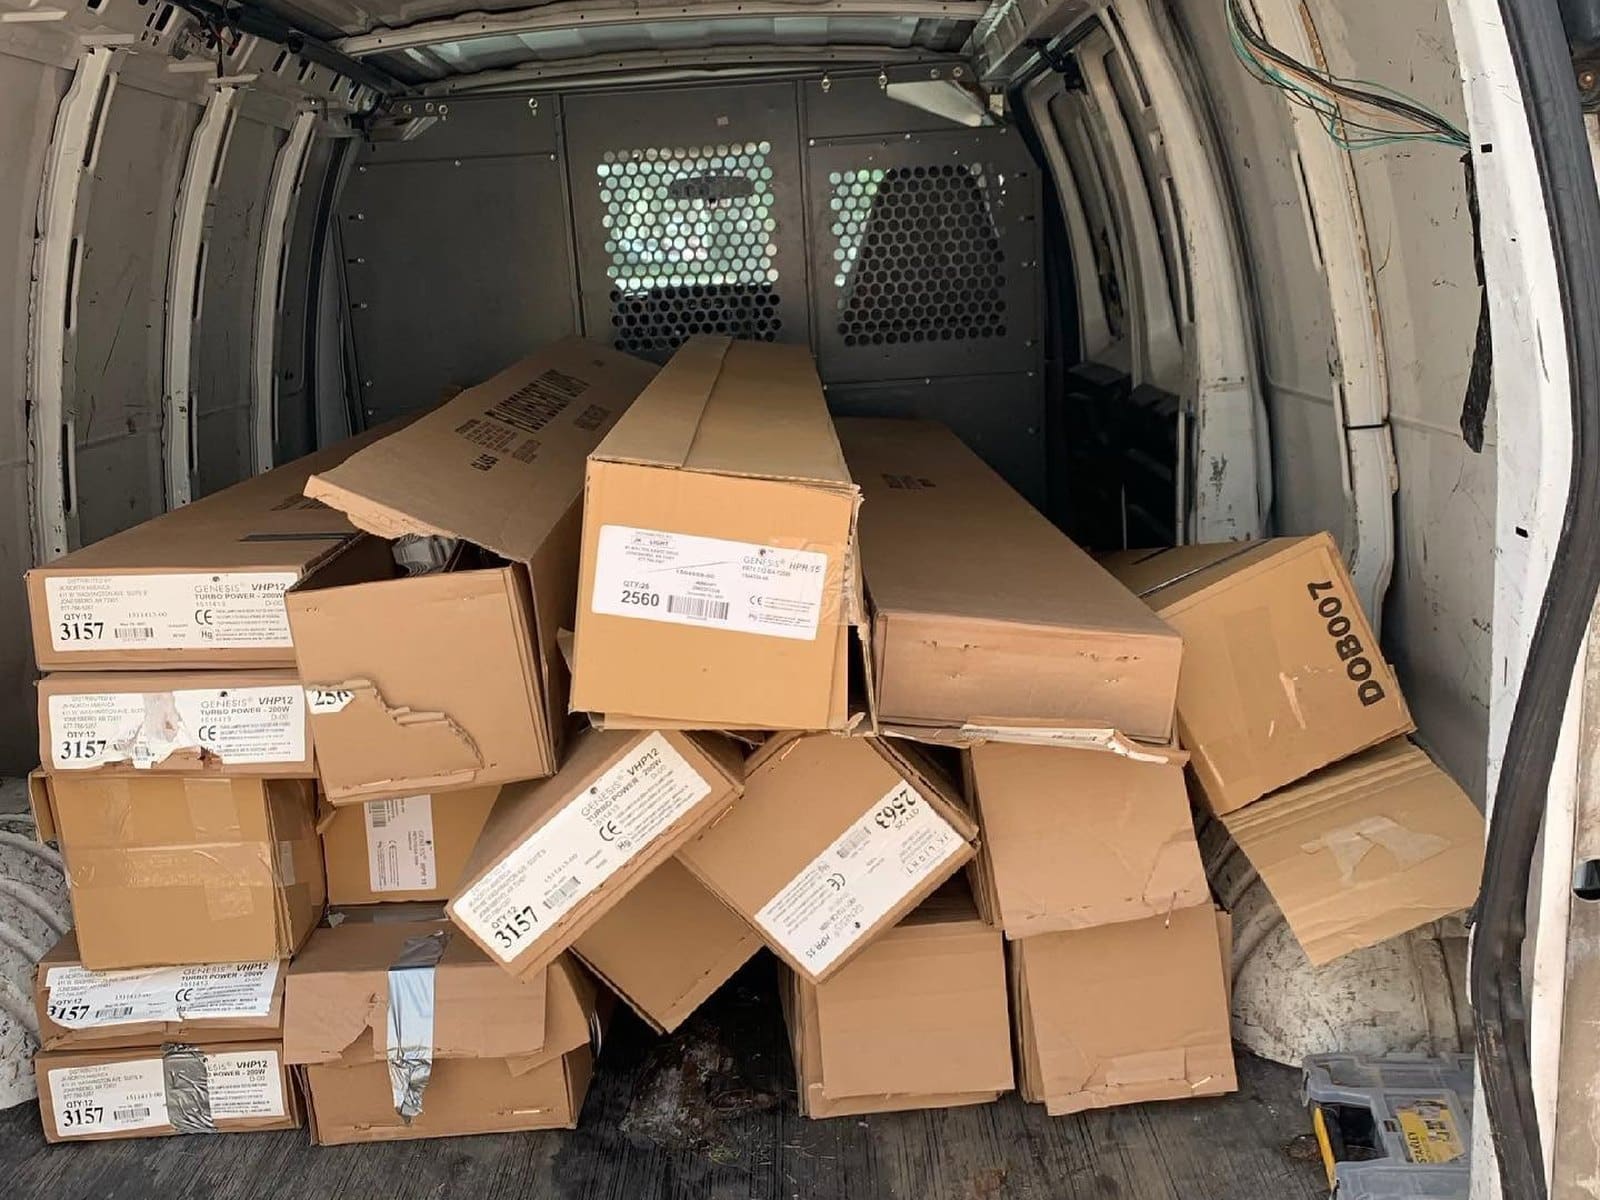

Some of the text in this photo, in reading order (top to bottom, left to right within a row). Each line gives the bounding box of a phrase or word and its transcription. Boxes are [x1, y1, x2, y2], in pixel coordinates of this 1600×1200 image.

[194, 583, 286, 593] GENESIS VHP12
[621, 590, 660, 607] 2560
[59, 622, 104, 641] 3157
[1307, 580, 1386, 707] DOB007
[201, 696, 294, 708] GENESIS VHP12
[60, 740, 107, 759] 3157
[581, 781, 621, 817] GENESIS
[627, 748, 660, 776] VHP12
[586, 801, 612, 822] TURBO
[611, 777, 639, 802] POWER
[875, 788, 916, 829] 2563
[495, 905, 538, 948] 3157
[183, 963, 269, 975] GENESIS VHP12
[48, 1005, 90, 1020] 3157
[236, 1060, 268, 1069] VHP12
[63, 1107, 104, 1127] 3157
